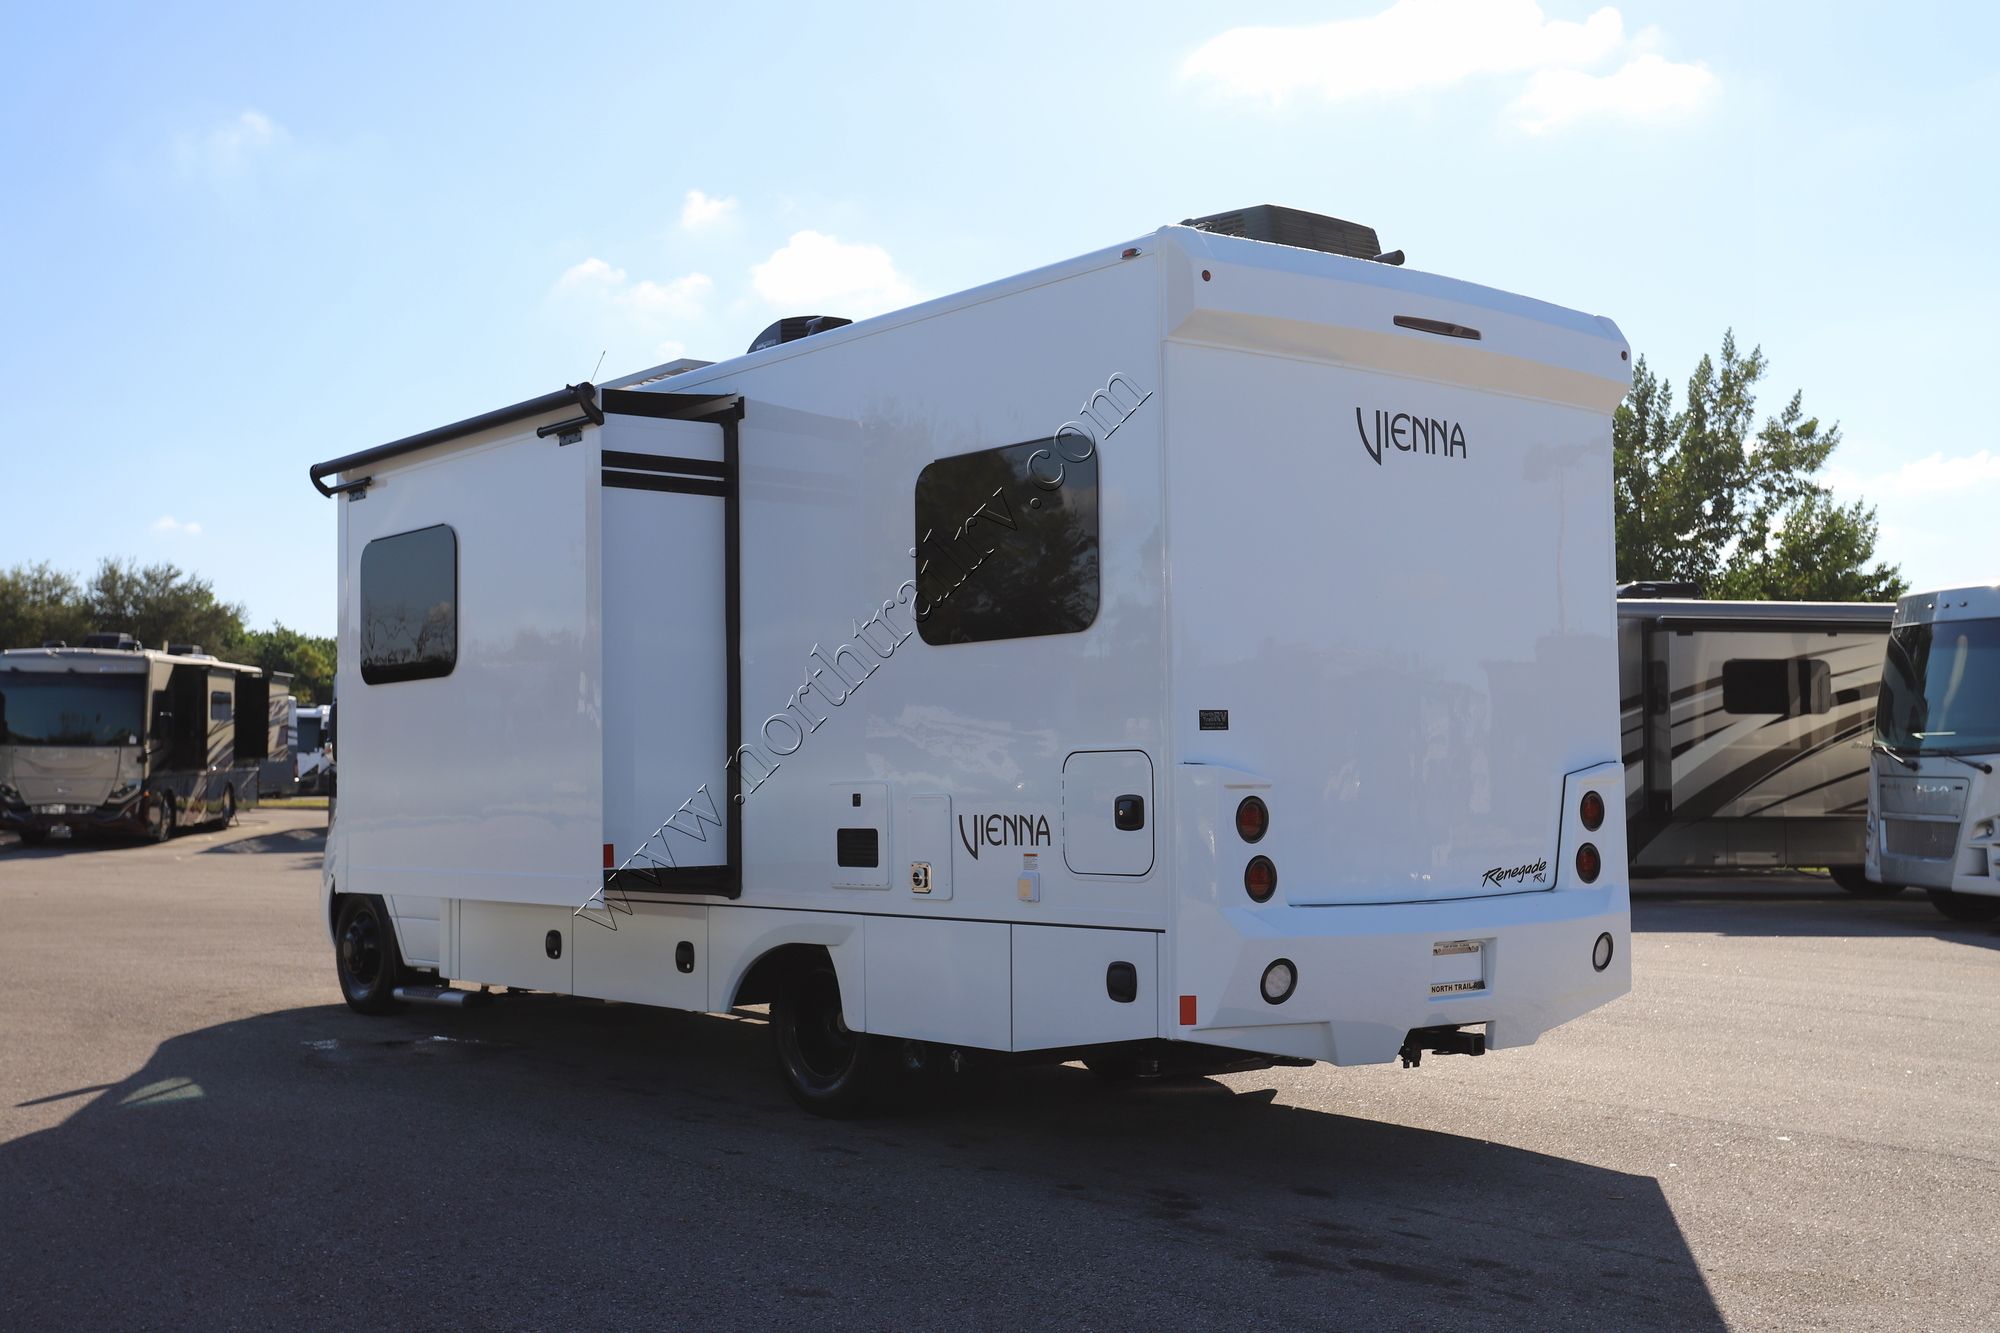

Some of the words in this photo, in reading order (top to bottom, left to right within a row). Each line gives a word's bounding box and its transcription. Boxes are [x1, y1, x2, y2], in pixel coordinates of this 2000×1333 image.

[1356, 407, 1467, 466] VIENNA
[959, 813, 1051, 861] VIENNA
[1482, 857, 1547, 888] Renegade
[1533, 873, 1547, 883] RV
[1431, 984, 1453, 993] NORTH
[1454, 982, 1472, 991] TRAIL
